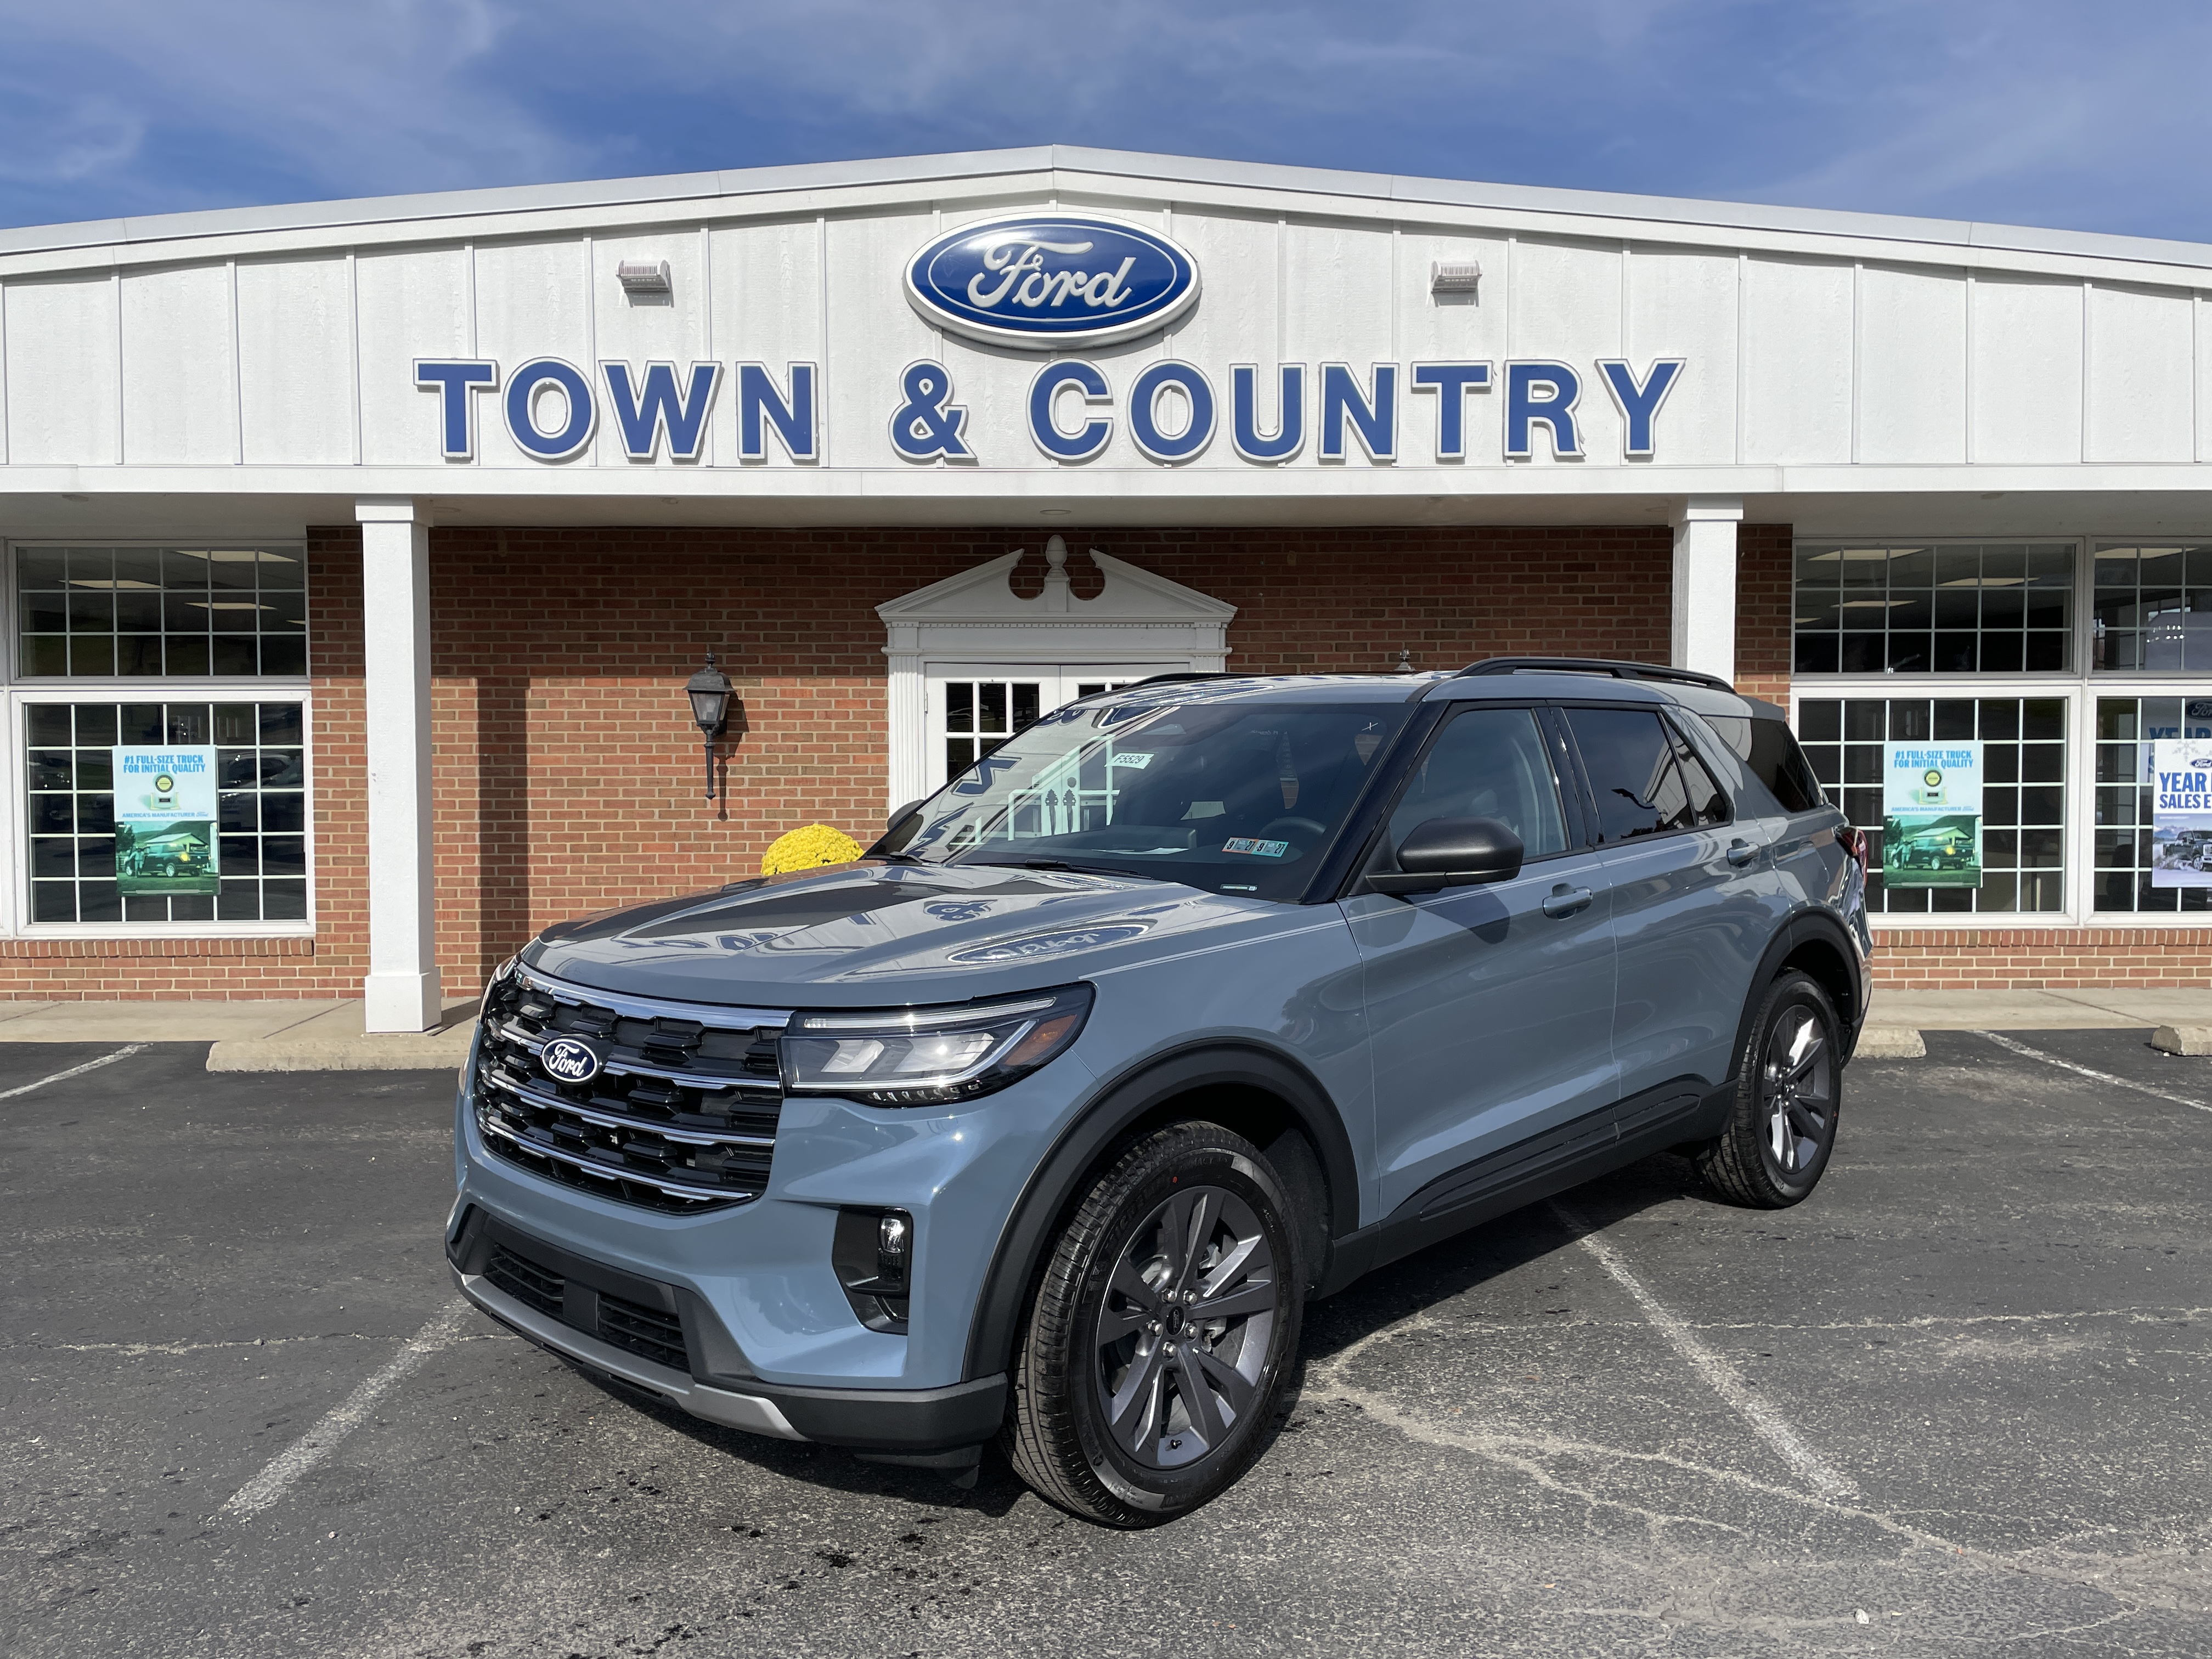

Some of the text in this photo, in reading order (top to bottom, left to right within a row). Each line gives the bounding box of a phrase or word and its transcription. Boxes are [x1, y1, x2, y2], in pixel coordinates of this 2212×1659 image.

[967, 239, 1137, 308] Ford
[413, 357, 1687, 462] TOWN & COUNTRY
[2191, 702, 2212, 716] For
[124, 754, 204, 764] #1 FULL-SIZE TRUCK
[1113, 754, 1146, 764] F5529
[1895, 750, 1972, 759] #1 FULL-SIZE TRUCK
[123, 763, 205, 774] FOR INITIAL QUALITY
[1894, 759, 1973, 769] FOR INITIAL QUALITY
[2159, 772, 2207, 792] YEAR
[2159, 794, 2200, 809] SALES
[549, 1043, 588, 1077] Ford
